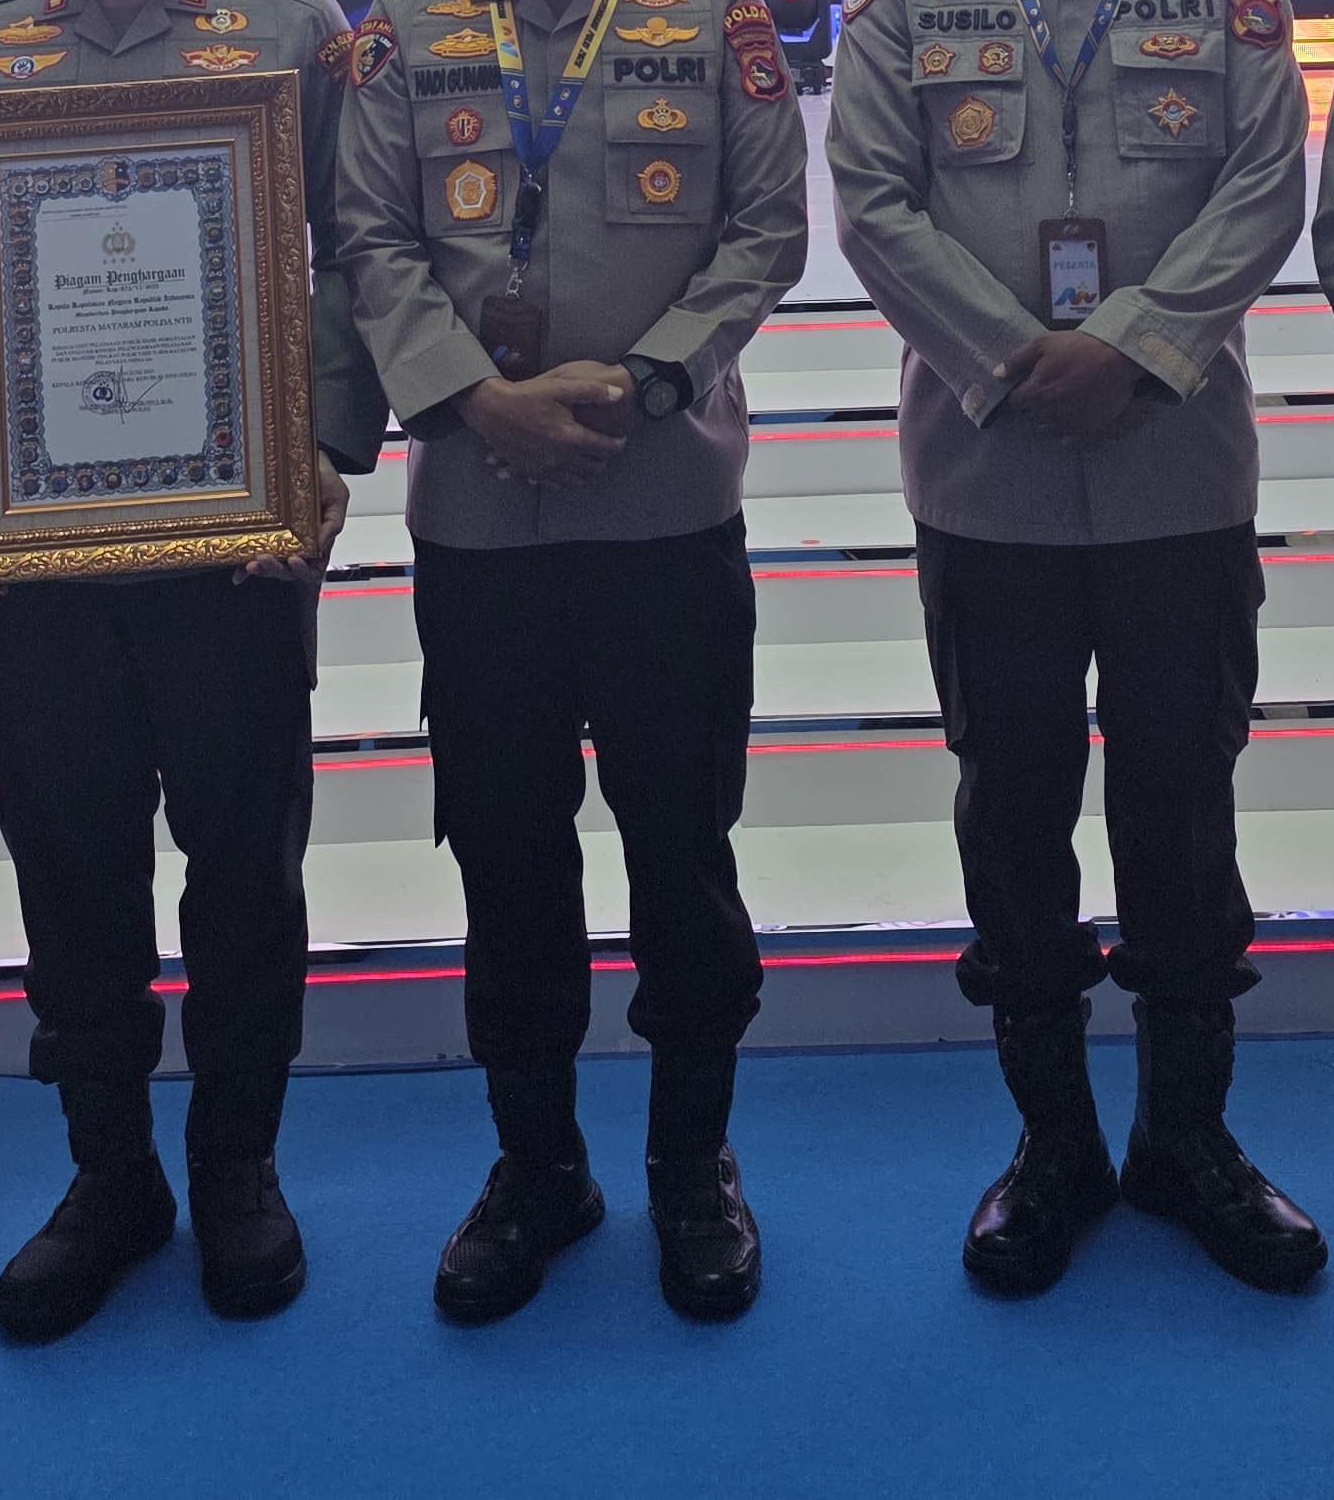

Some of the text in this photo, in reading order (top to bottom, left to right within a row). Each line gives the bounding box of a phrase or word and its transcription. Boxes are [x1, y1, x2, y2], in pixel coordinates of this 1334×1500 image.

[724, 5, 769, 29] POLDA
[918, 8, 1017, 33] SUSILO
[447, 64, 504, 93] GUNAWA
[614, 56, 705, 83] POLRI
[1053, 260, 1097, 270] PESERTA
[54, 268, 186, 290] Piagam Penghargaan
[52, 324, 96, 335] POLRESTA
[98, 320, 142, 331] MATARAM
[143, 318, 173, 328] POLDA
